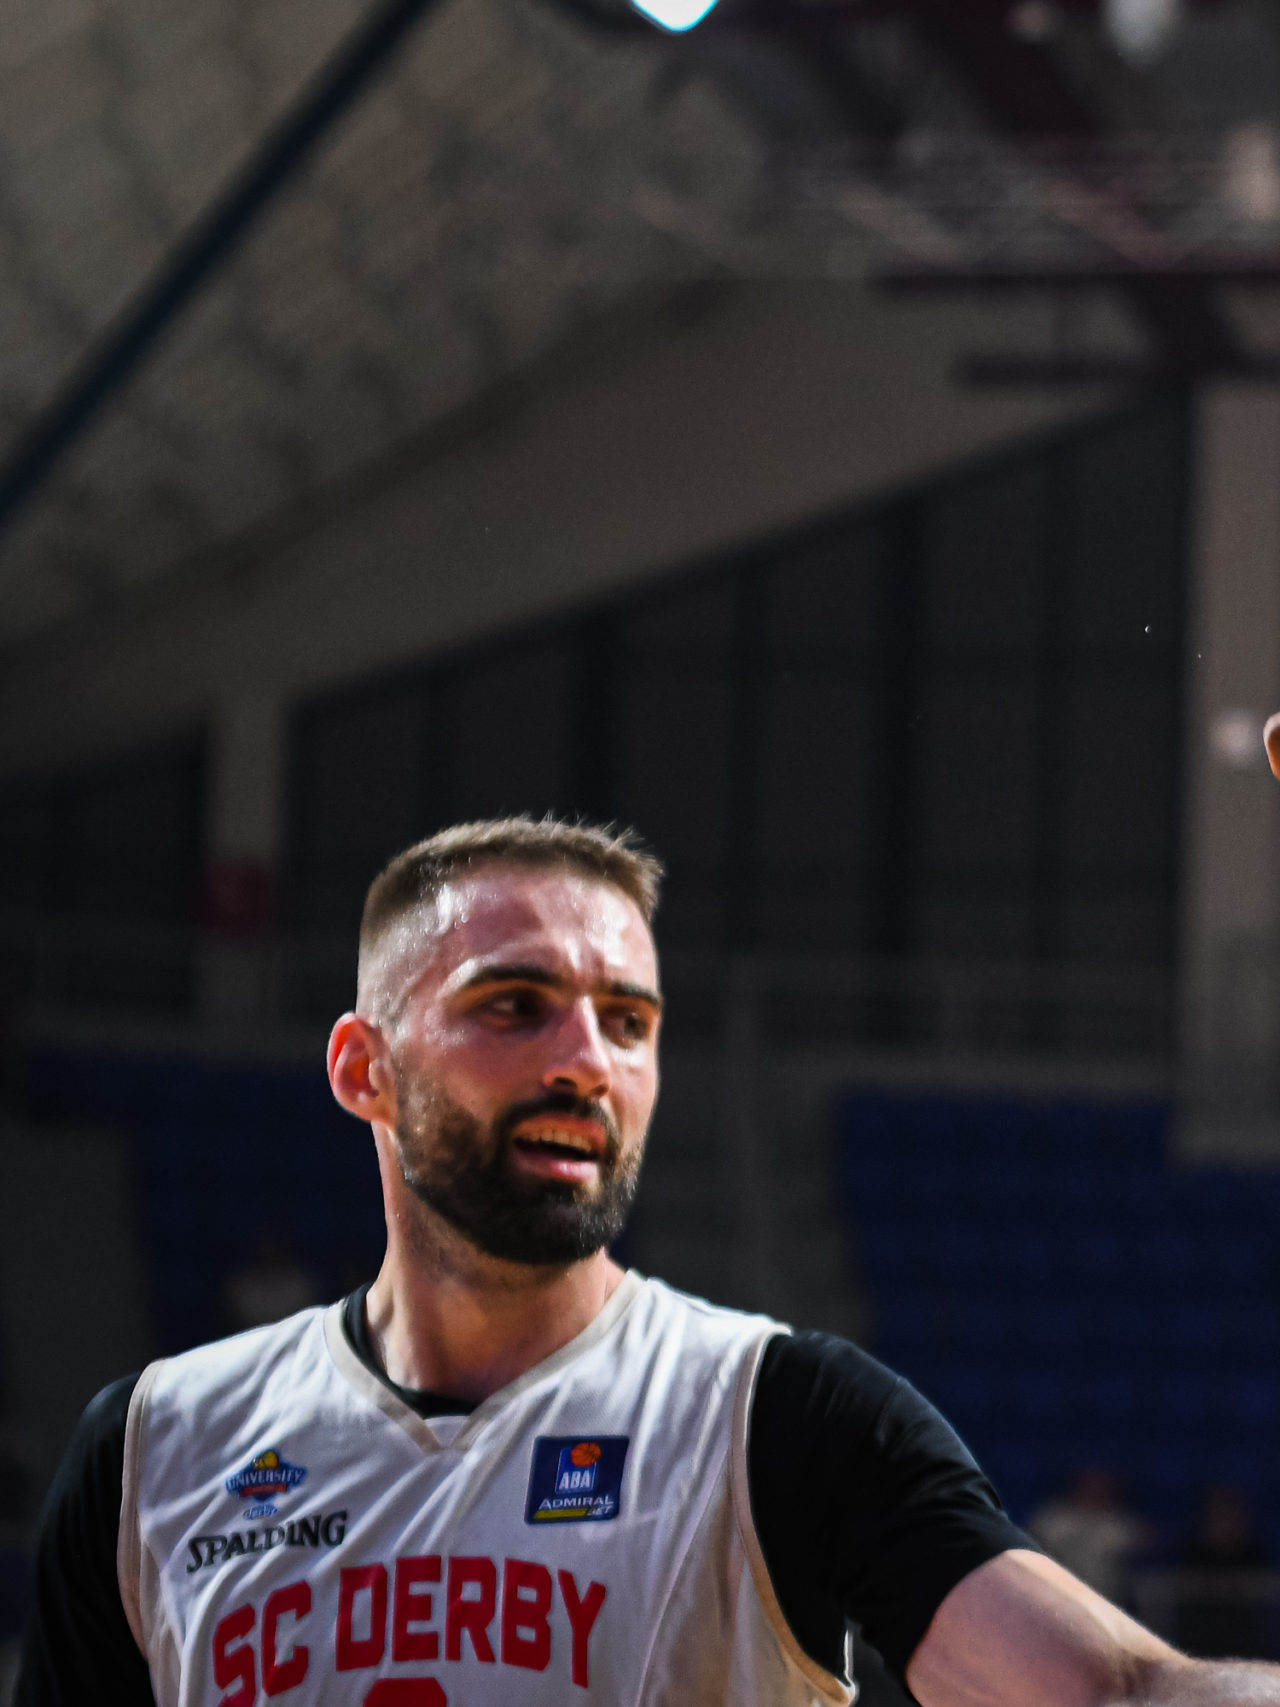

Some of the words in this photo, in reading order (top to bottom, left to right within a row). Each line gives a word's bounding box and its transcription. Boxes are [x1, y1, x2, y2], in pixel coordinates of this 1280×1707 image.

[226, 1467, 304, 1490] UNIVERSITY
[559, 1469, 593, 1491] ABA
[538, 1495, 614, 1510] ADMIRAL
[186, 1511, 348, 1573] SPALDING
[212, 1579, 313, 1707] SC
[335, 1554, 607, 1689] DERBY
